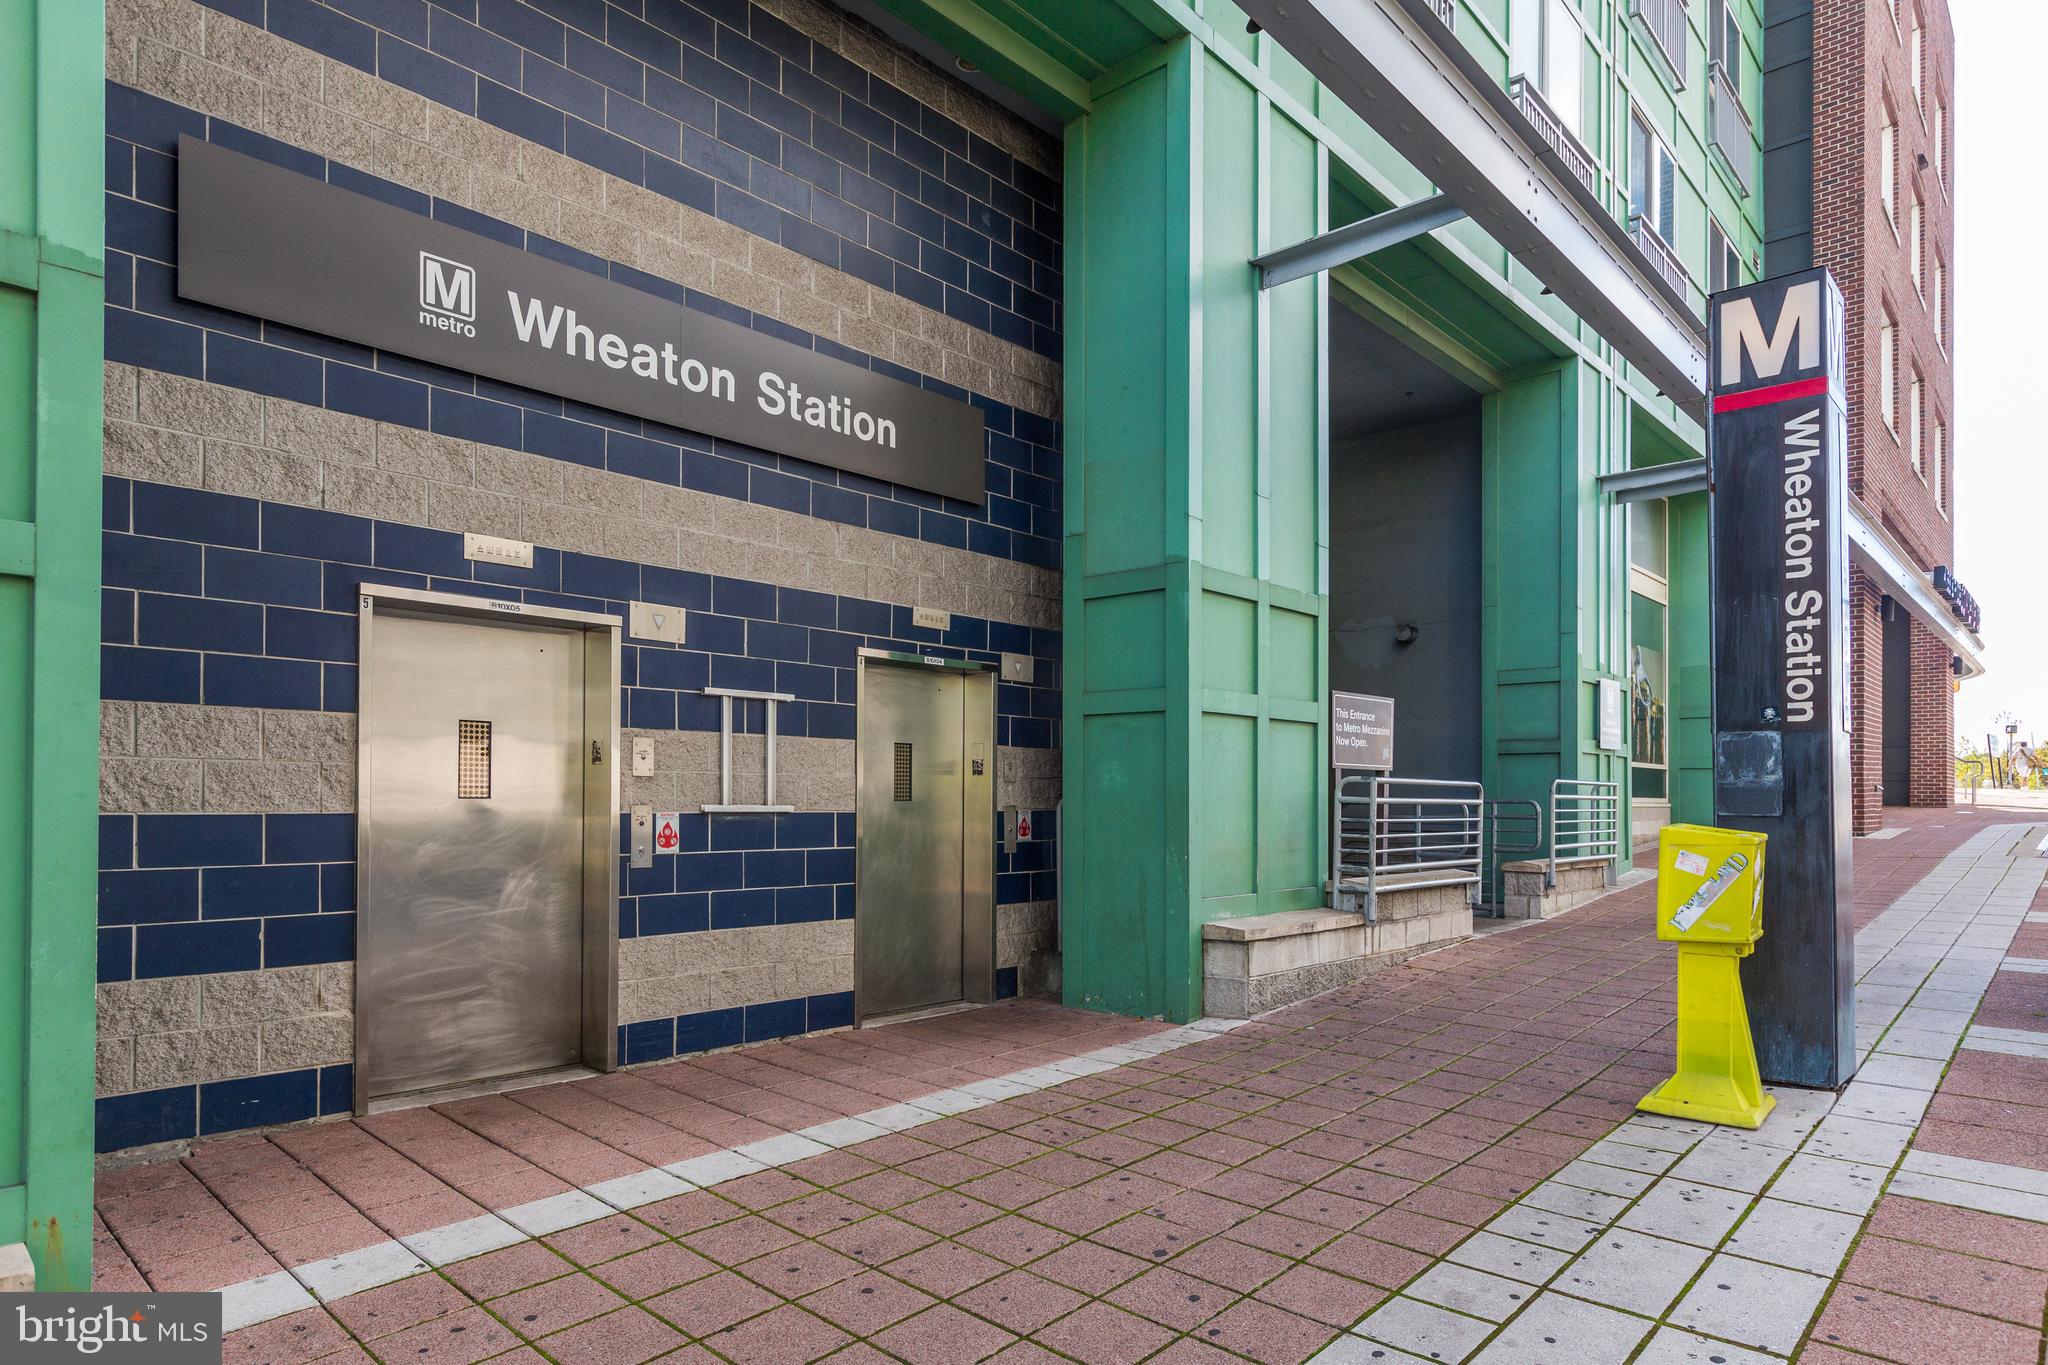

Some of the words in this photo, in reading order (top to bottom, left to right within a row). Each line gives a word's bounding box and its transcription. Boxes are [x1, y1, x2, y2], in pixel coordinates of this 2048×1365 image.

[426, 259, 470, 315] M
[419, 311, 476, 338] metro
[1721, 280, 1820, 386] M
[507, 290, 736, 403] Wheaton
[757, 371, 897, 449] Station
[1784, 408, 1820, 580] Wheaton
[362, 597, 369, 609] 5
[1784, 590, 1823, 723] Station
[1336, 707, 1348, 718] This
[1350, 709, 1375, 721] Entrance
[1336, 722, 1343, 732] to
[1343, 723, 1361, 734] Metro
[1362, 724, 1390, 736] Mezzanine
[1336, 735, 1350, 746] Now
[1350, 736, 1368, 748] Open.
